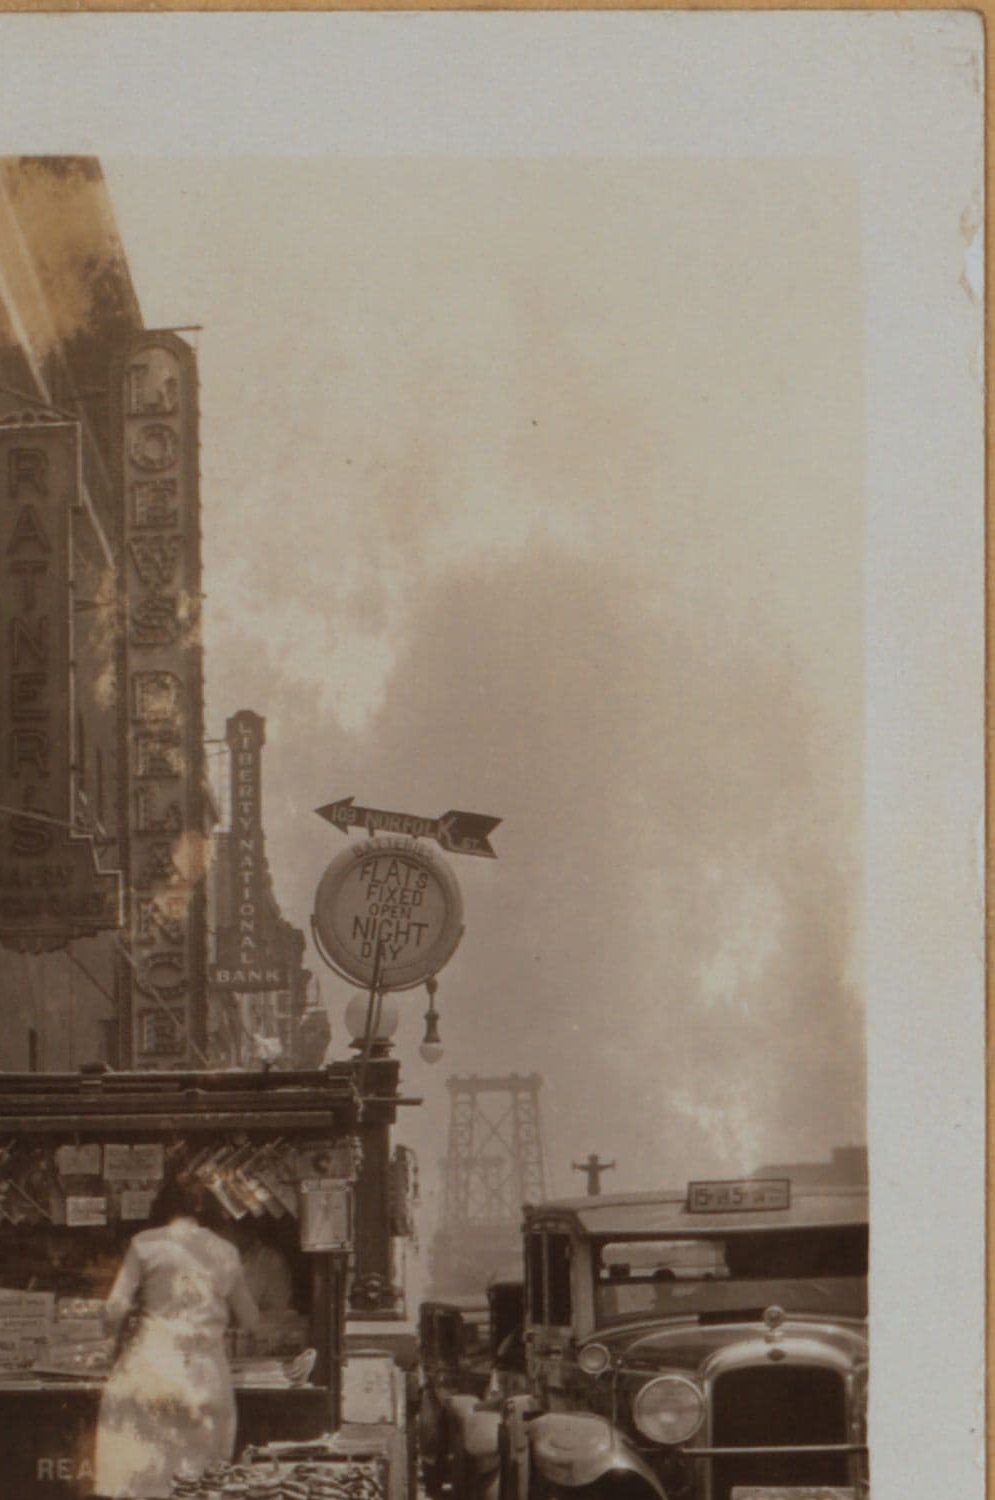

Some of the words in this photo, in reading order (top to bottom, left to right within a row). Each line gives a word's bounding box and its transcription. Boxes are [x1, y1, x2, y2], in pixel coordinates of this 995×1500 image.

[238, 720, 254, 832] LIBERTY
[331, 804, 357, 824] 103
[364, 811, 457, 846] NORFOLK
[130, 670, 188, 1068] DELANCE
[360, 858, 429, 890] FLATS
[239, 839, 255, 964] NATIONAL
[366, 883, 423, 907] FIXED
[369, 903, 412, 920] OPEN
[352, 915, 430, 948] NIGHT
[360, 941, 403, 961] DAY
[217, 969, 280, 984] BANK
[36, 1457, 96, 1481] REA
